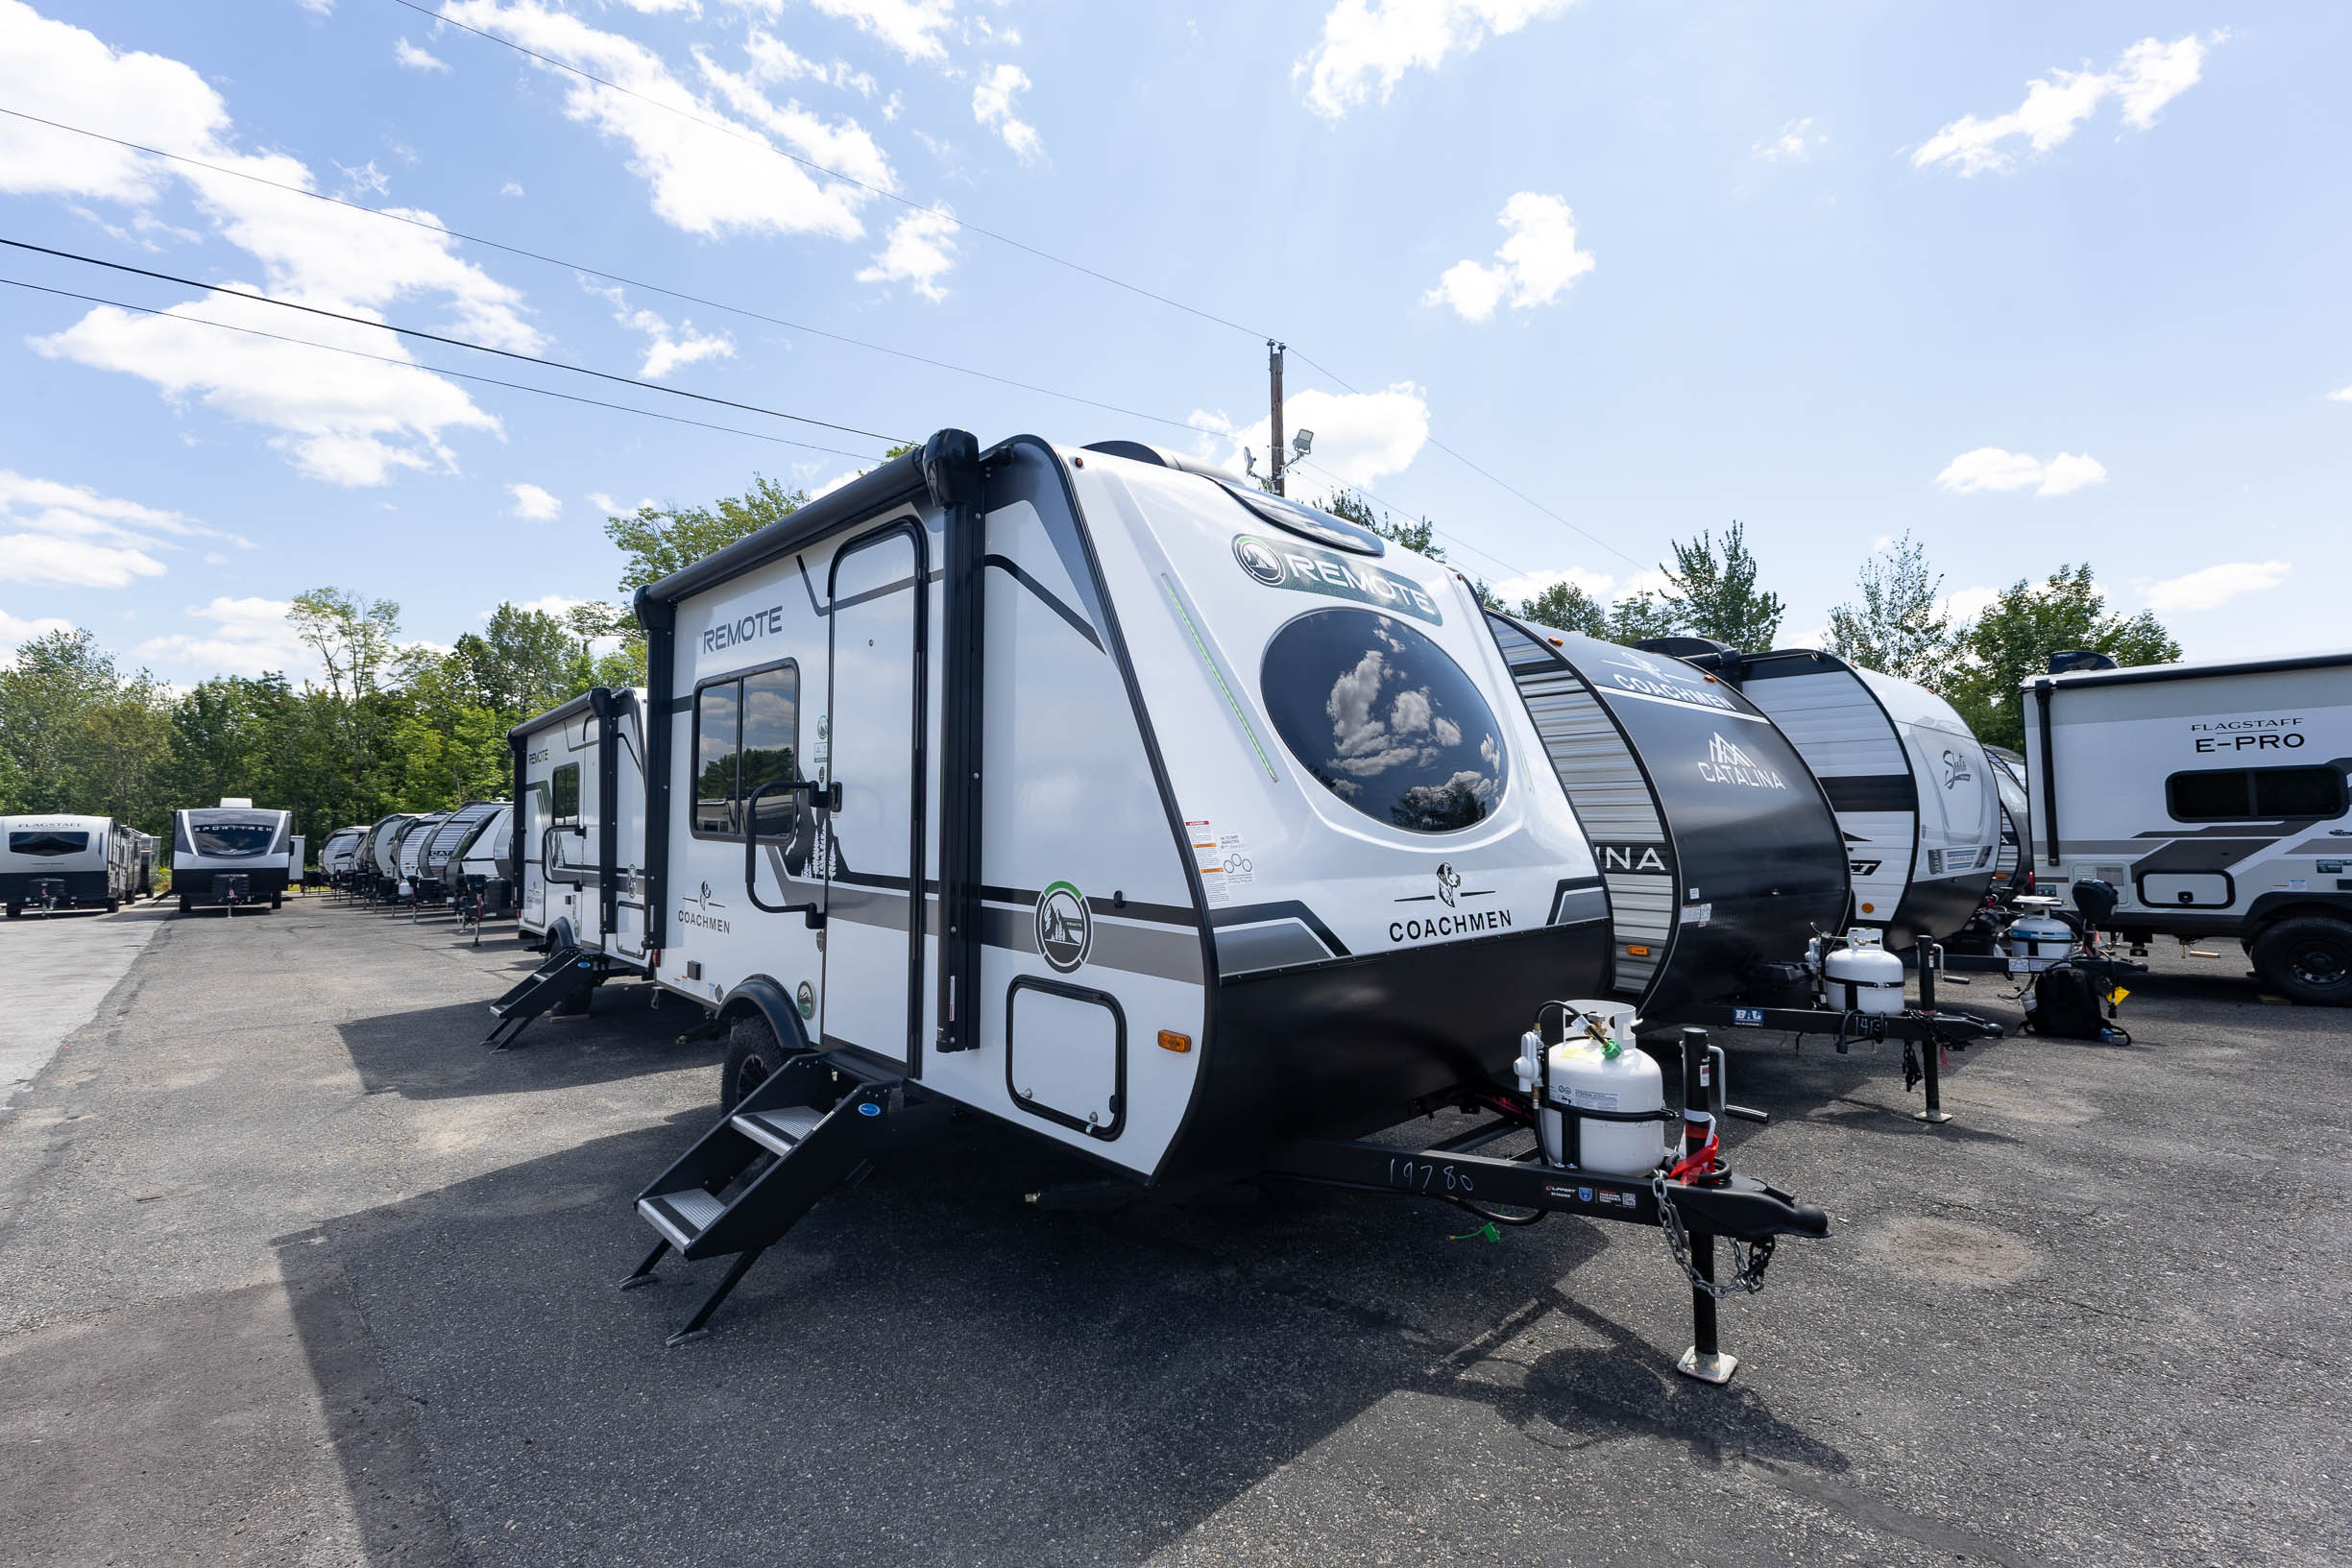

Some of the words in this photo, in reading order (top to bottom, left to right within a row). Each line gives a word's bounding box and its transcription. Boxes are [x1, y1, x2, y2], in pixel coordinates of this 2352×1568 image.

[1284, 552, 1436, 615] REMOTE
[703, 605, 783, 654] REMOTE
[1612, 673, 1737, 712] COACHMEN
[2190, 717, 2304, 732] FLAGSTAFF
[2195, 733, 2305, 753] E-PRO
[1697, 761, 1786, 790] CATALINA
[678, 909, 730, 934] COACHMEN
[1389, 908, 1513, 943] COACHMEN
[1390, 1158, 1474, 1192] 19780
